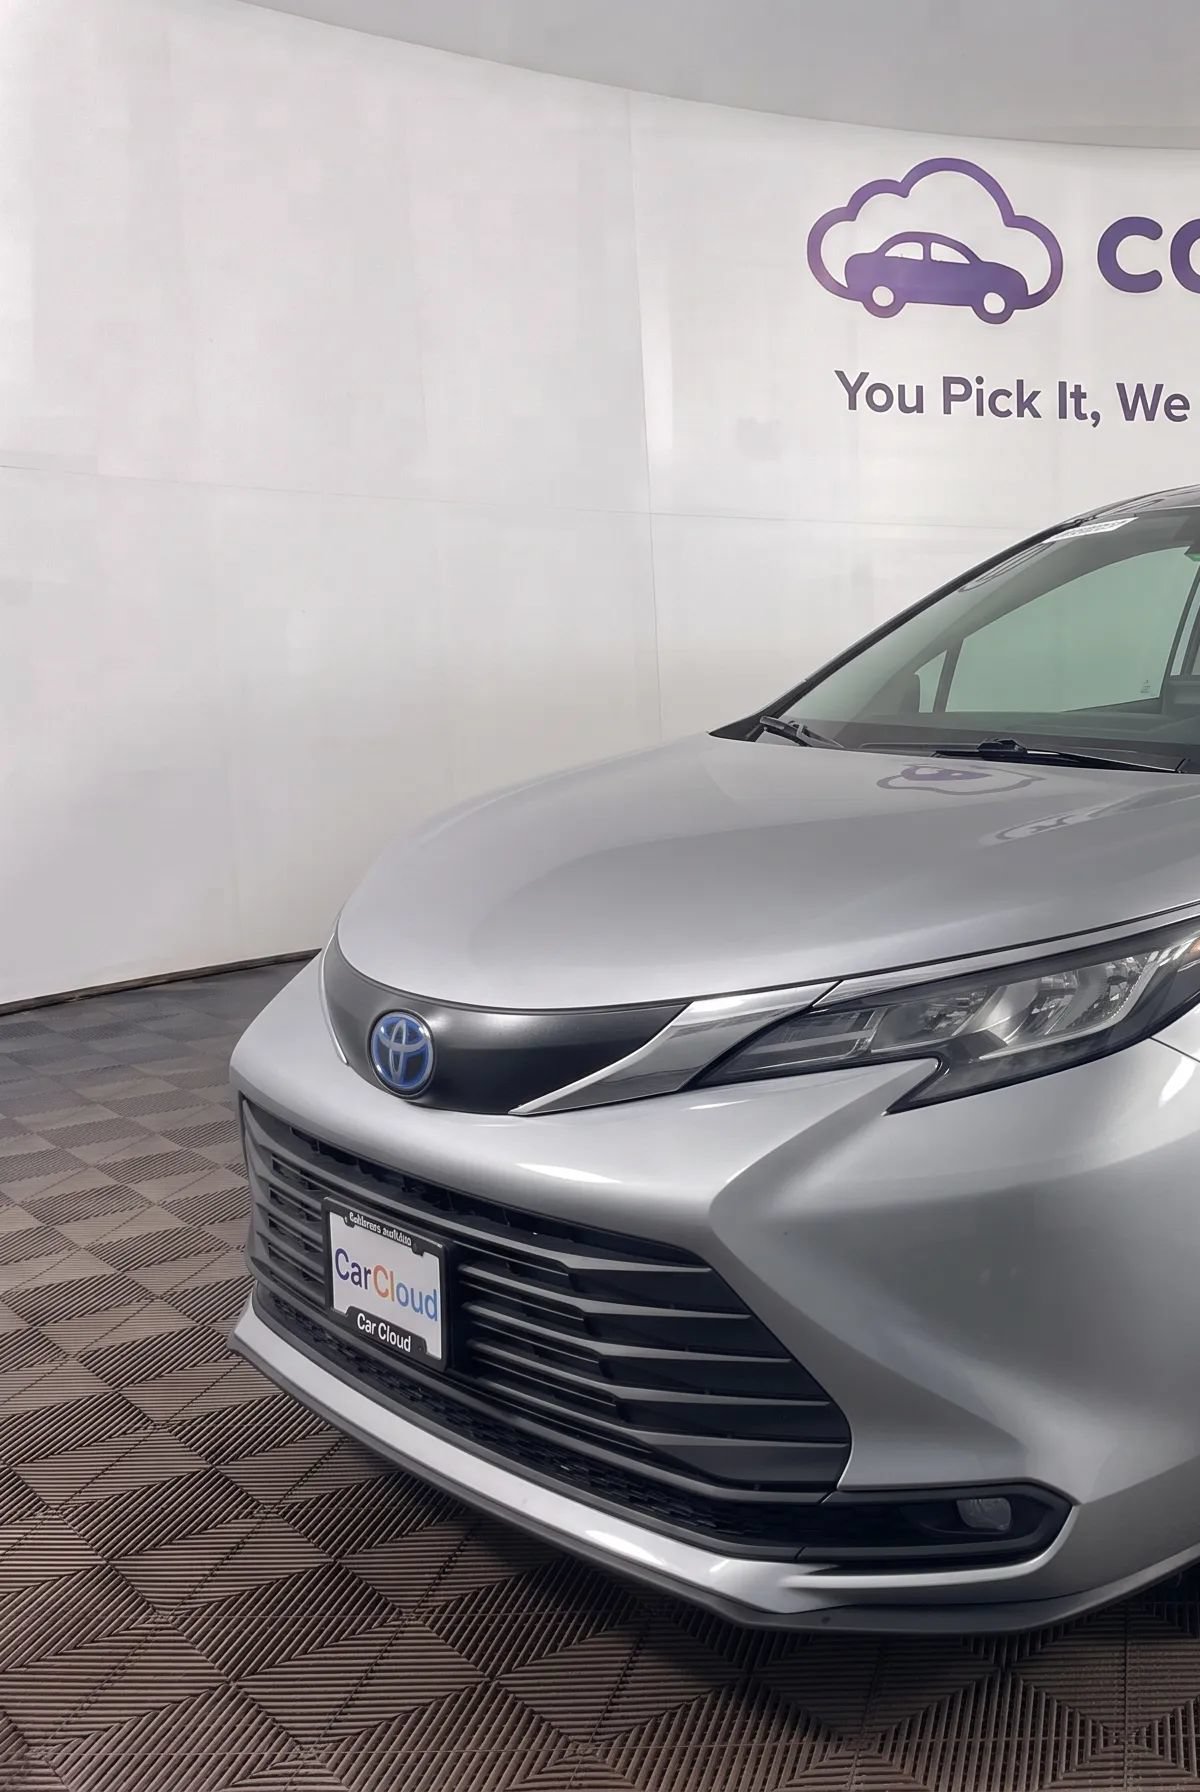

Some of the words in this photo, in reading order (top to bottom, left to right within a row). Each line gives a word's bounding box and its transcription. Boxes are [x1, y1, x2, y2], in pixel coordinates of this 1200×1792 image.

[834, 370, 924, 414] You
[942, 375, 1042, 419] Pick
[1058, 380, 1101, 428] It,
[1115, 382, 1191, 423] We
[335, 1248, 438, 1321] CarCloud
[357, 1313, 375, 1335] Car
[378, 1323, 411, 1352] Cloud
